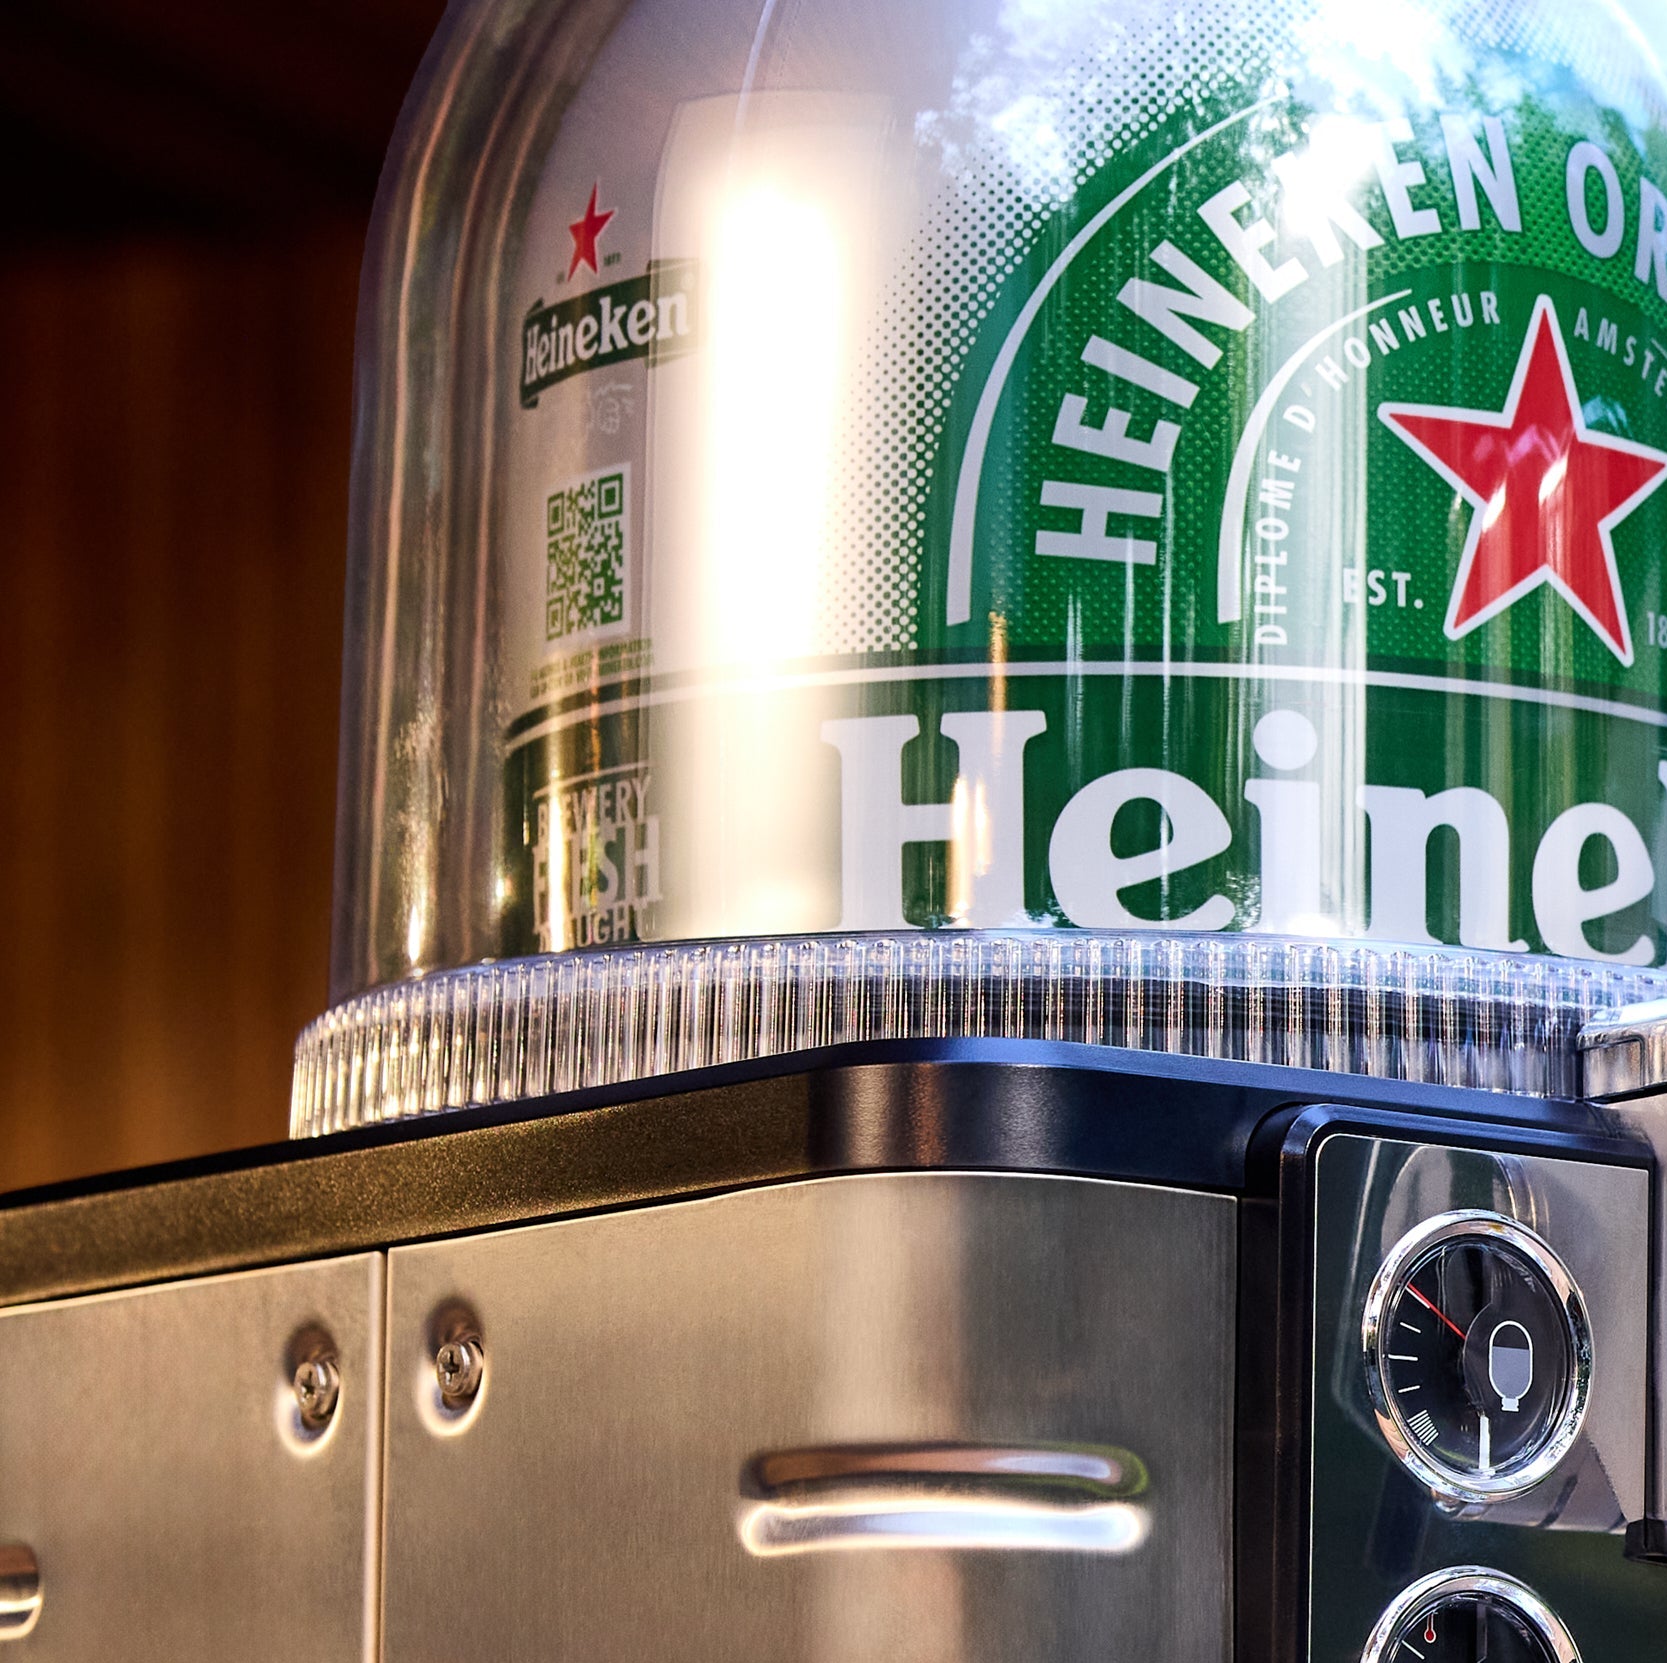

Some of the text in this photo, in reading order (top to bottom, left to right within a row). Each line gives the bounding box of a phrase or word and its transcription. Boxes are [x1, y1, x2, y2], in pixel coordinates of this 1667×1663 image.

[524, 294, 690, 386] Heineken
[1253, 449, 1302, 645] DIPLOME
[1282, 290, 1500, 434] D'HONNEUR
[1342, 567, 1424, 609] EST.
[538, 775, 652, 841] BEWERY
[532, 815, 664, 935] FESH
